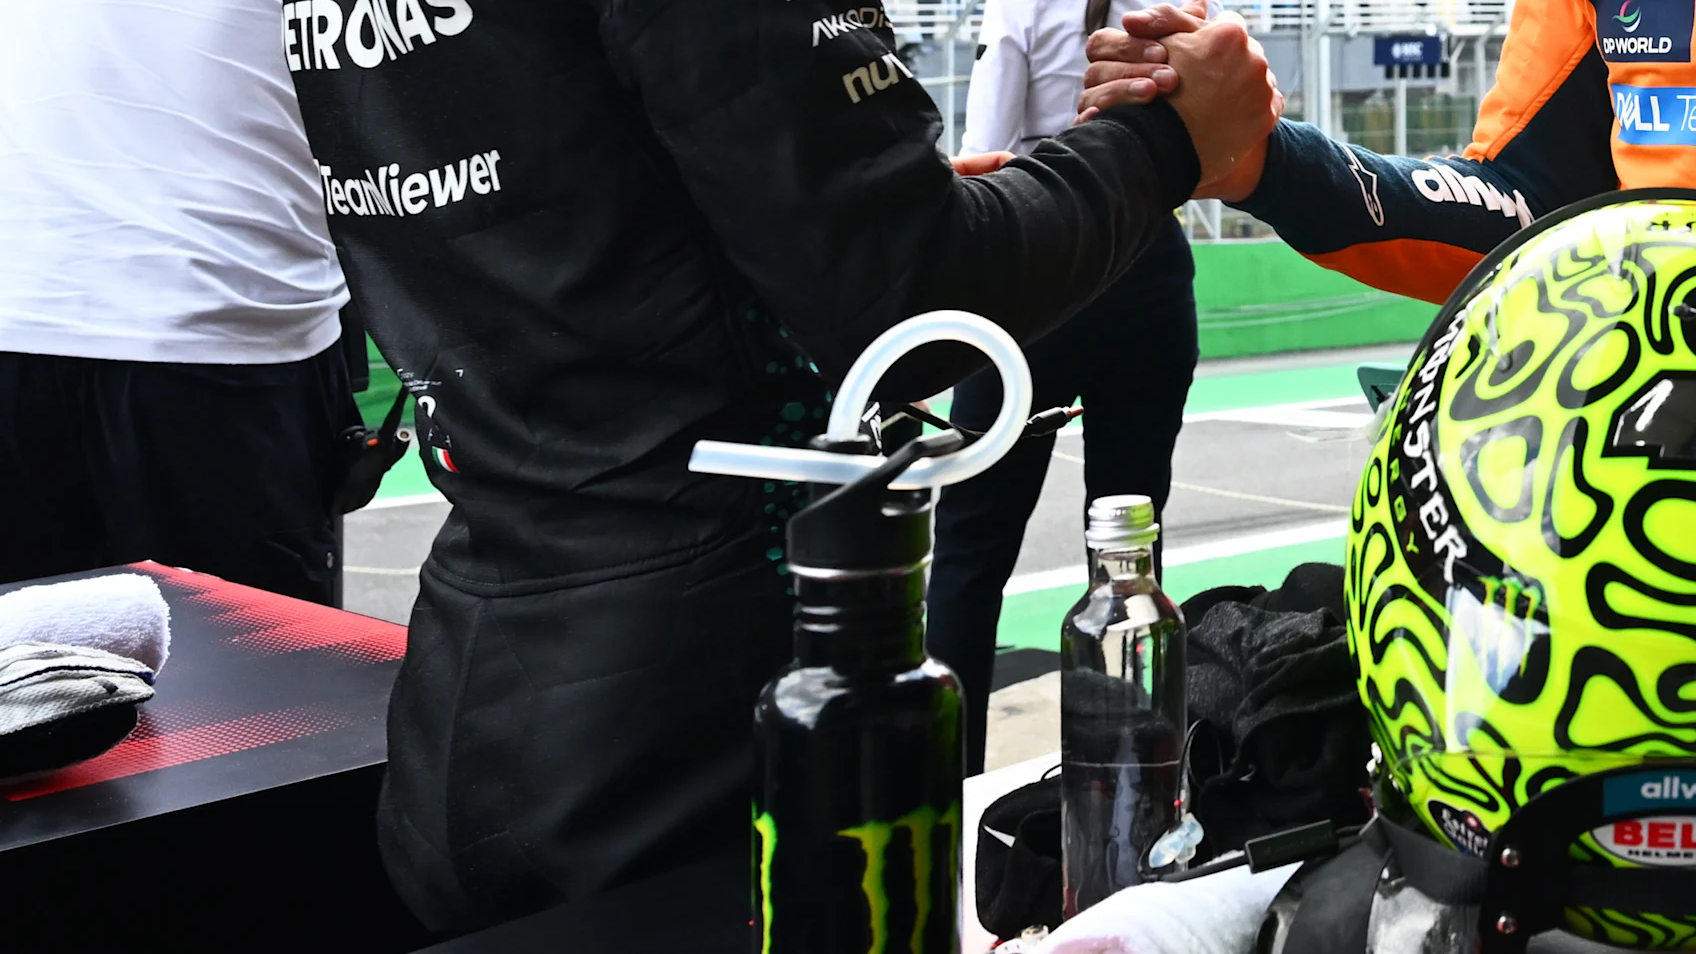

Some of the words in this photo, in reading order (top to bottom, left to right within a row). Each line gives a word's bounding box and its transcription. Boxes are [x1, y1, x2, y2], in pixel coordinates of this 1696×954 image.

[1615, 37, 1672, 54] WORLD
[1616, 92, 1670, 131] DELL
[320, 149, 501, 217] TeamViewer
